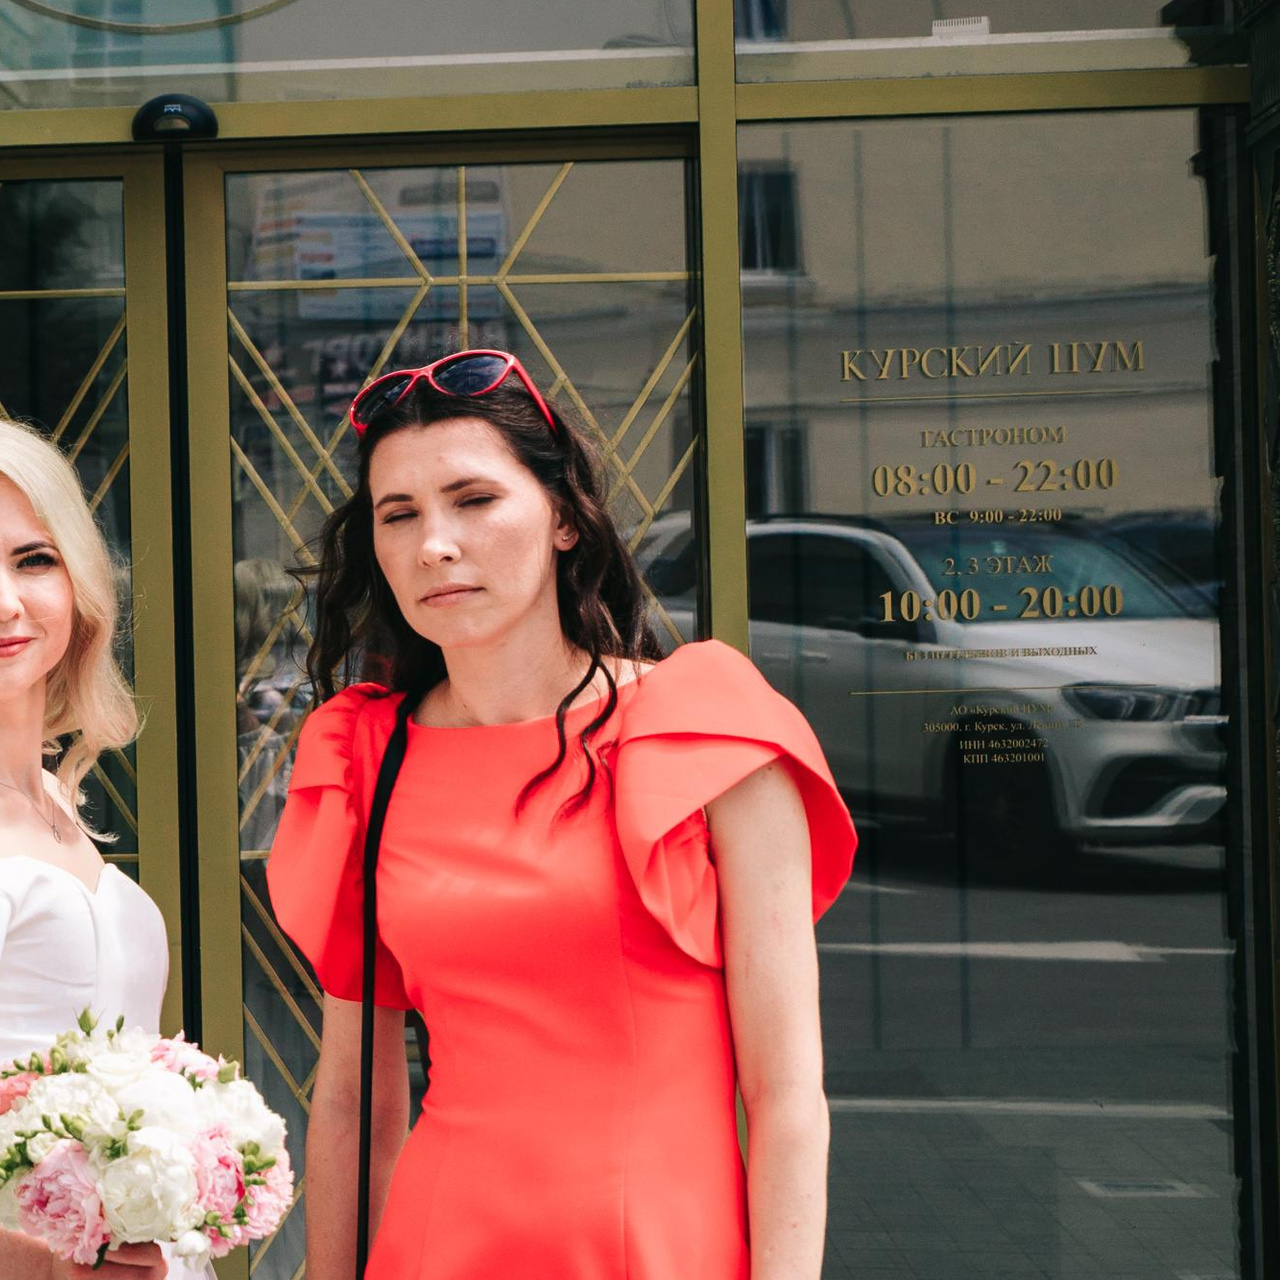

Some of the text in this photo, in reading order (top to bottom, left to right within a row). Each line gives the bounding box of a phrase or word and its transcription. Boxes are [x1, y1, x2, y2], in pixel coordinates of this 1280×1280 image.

[840, 340, 1145, 381] КУРСКИЙ ЦУМ
[920, 425, 1067, 448] ГАСТРОНОМ
[872, 462, 976, 497] 08:00
[1012, 457, 1118, 493] 22:00
[934, 510, 960, 525] ВС
[969, 509, 1004, 524] 9:00
[1018, 507, 1062, 523] 22:00
[968, 557, 979, 574] 3
[986, 554, 1054, 575] ЭТАЖ
[879, 588, 981, 622] 10:00
[1019, 584, 1124, 618] 20:00
[1023, 646, 1098, 658] ВЫХОДНЫХ
